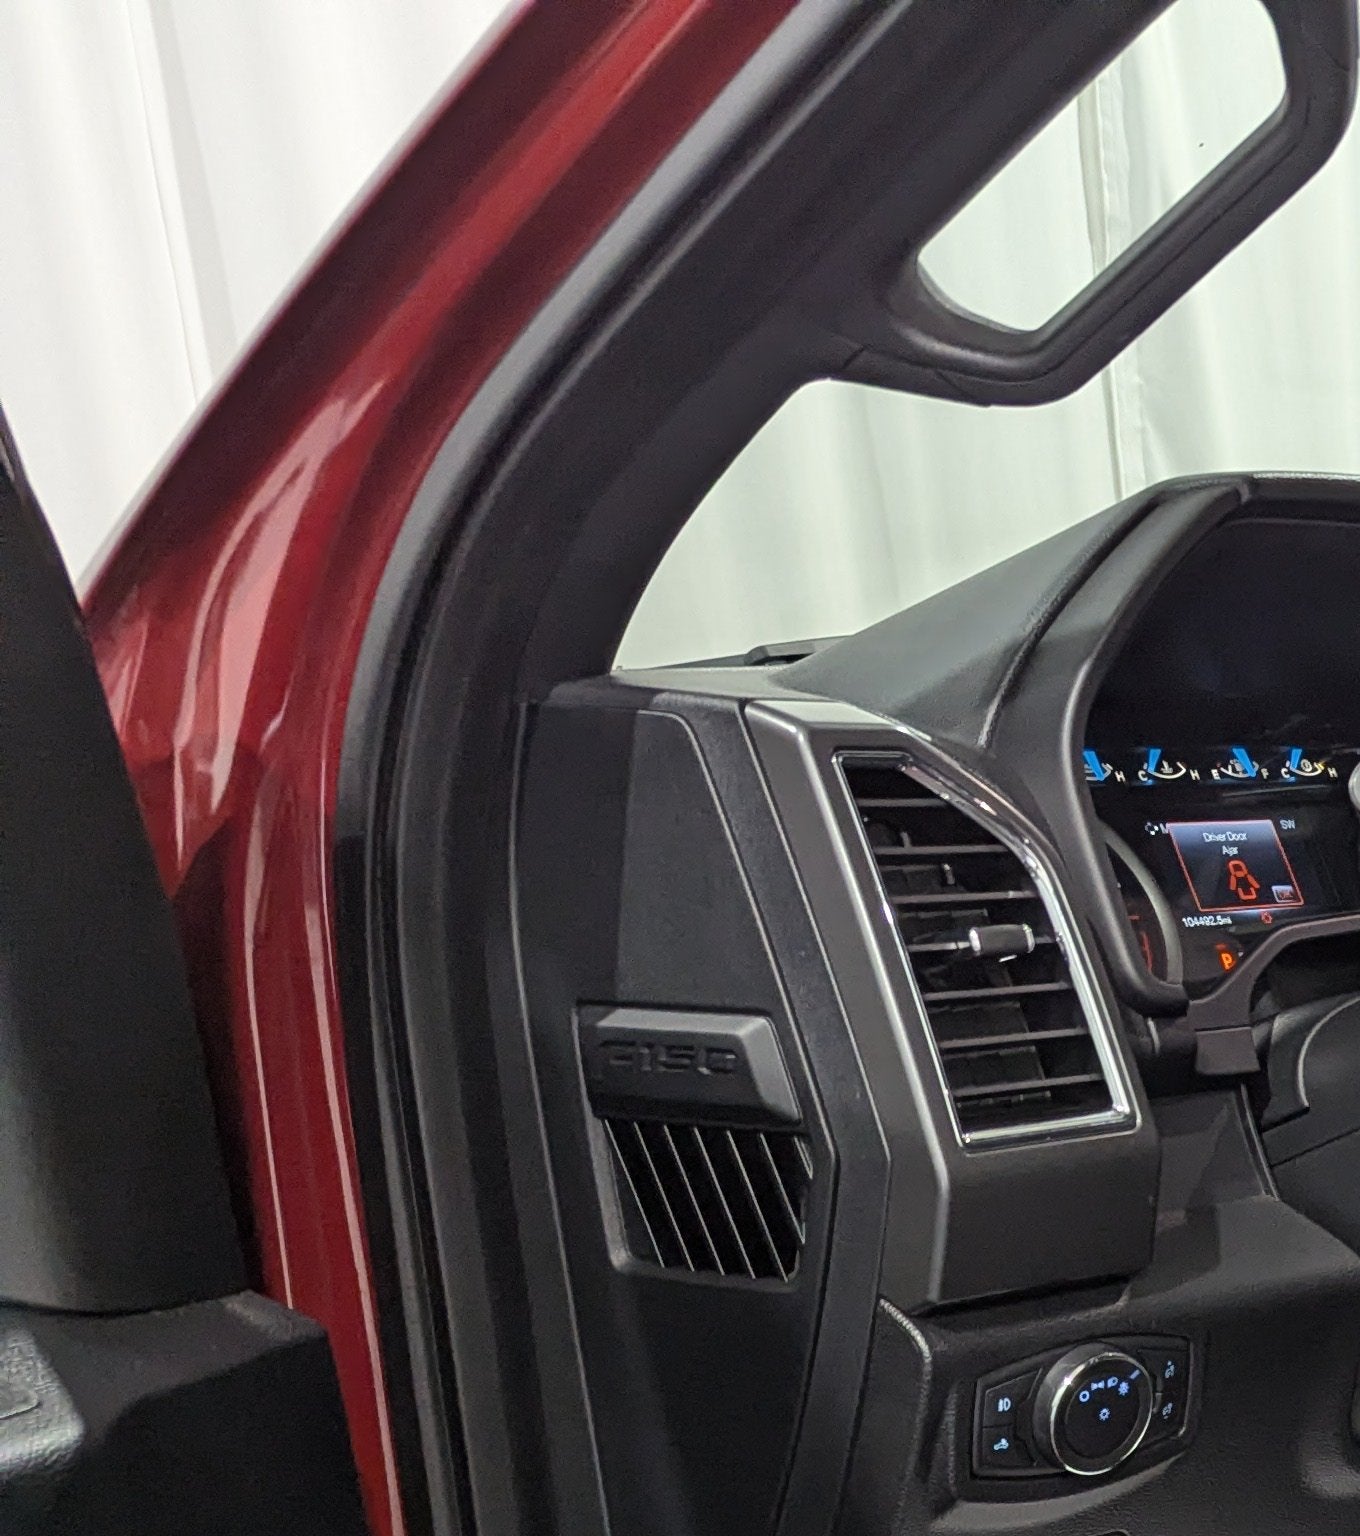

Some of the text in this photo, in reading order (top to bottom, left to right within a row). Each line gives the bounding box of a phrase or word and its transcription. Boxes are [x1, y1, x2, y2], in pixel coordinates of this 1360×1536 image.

[1203, 831, 1248, 843] Driver Door
[1222, 845, 1239, 857] Ajar
